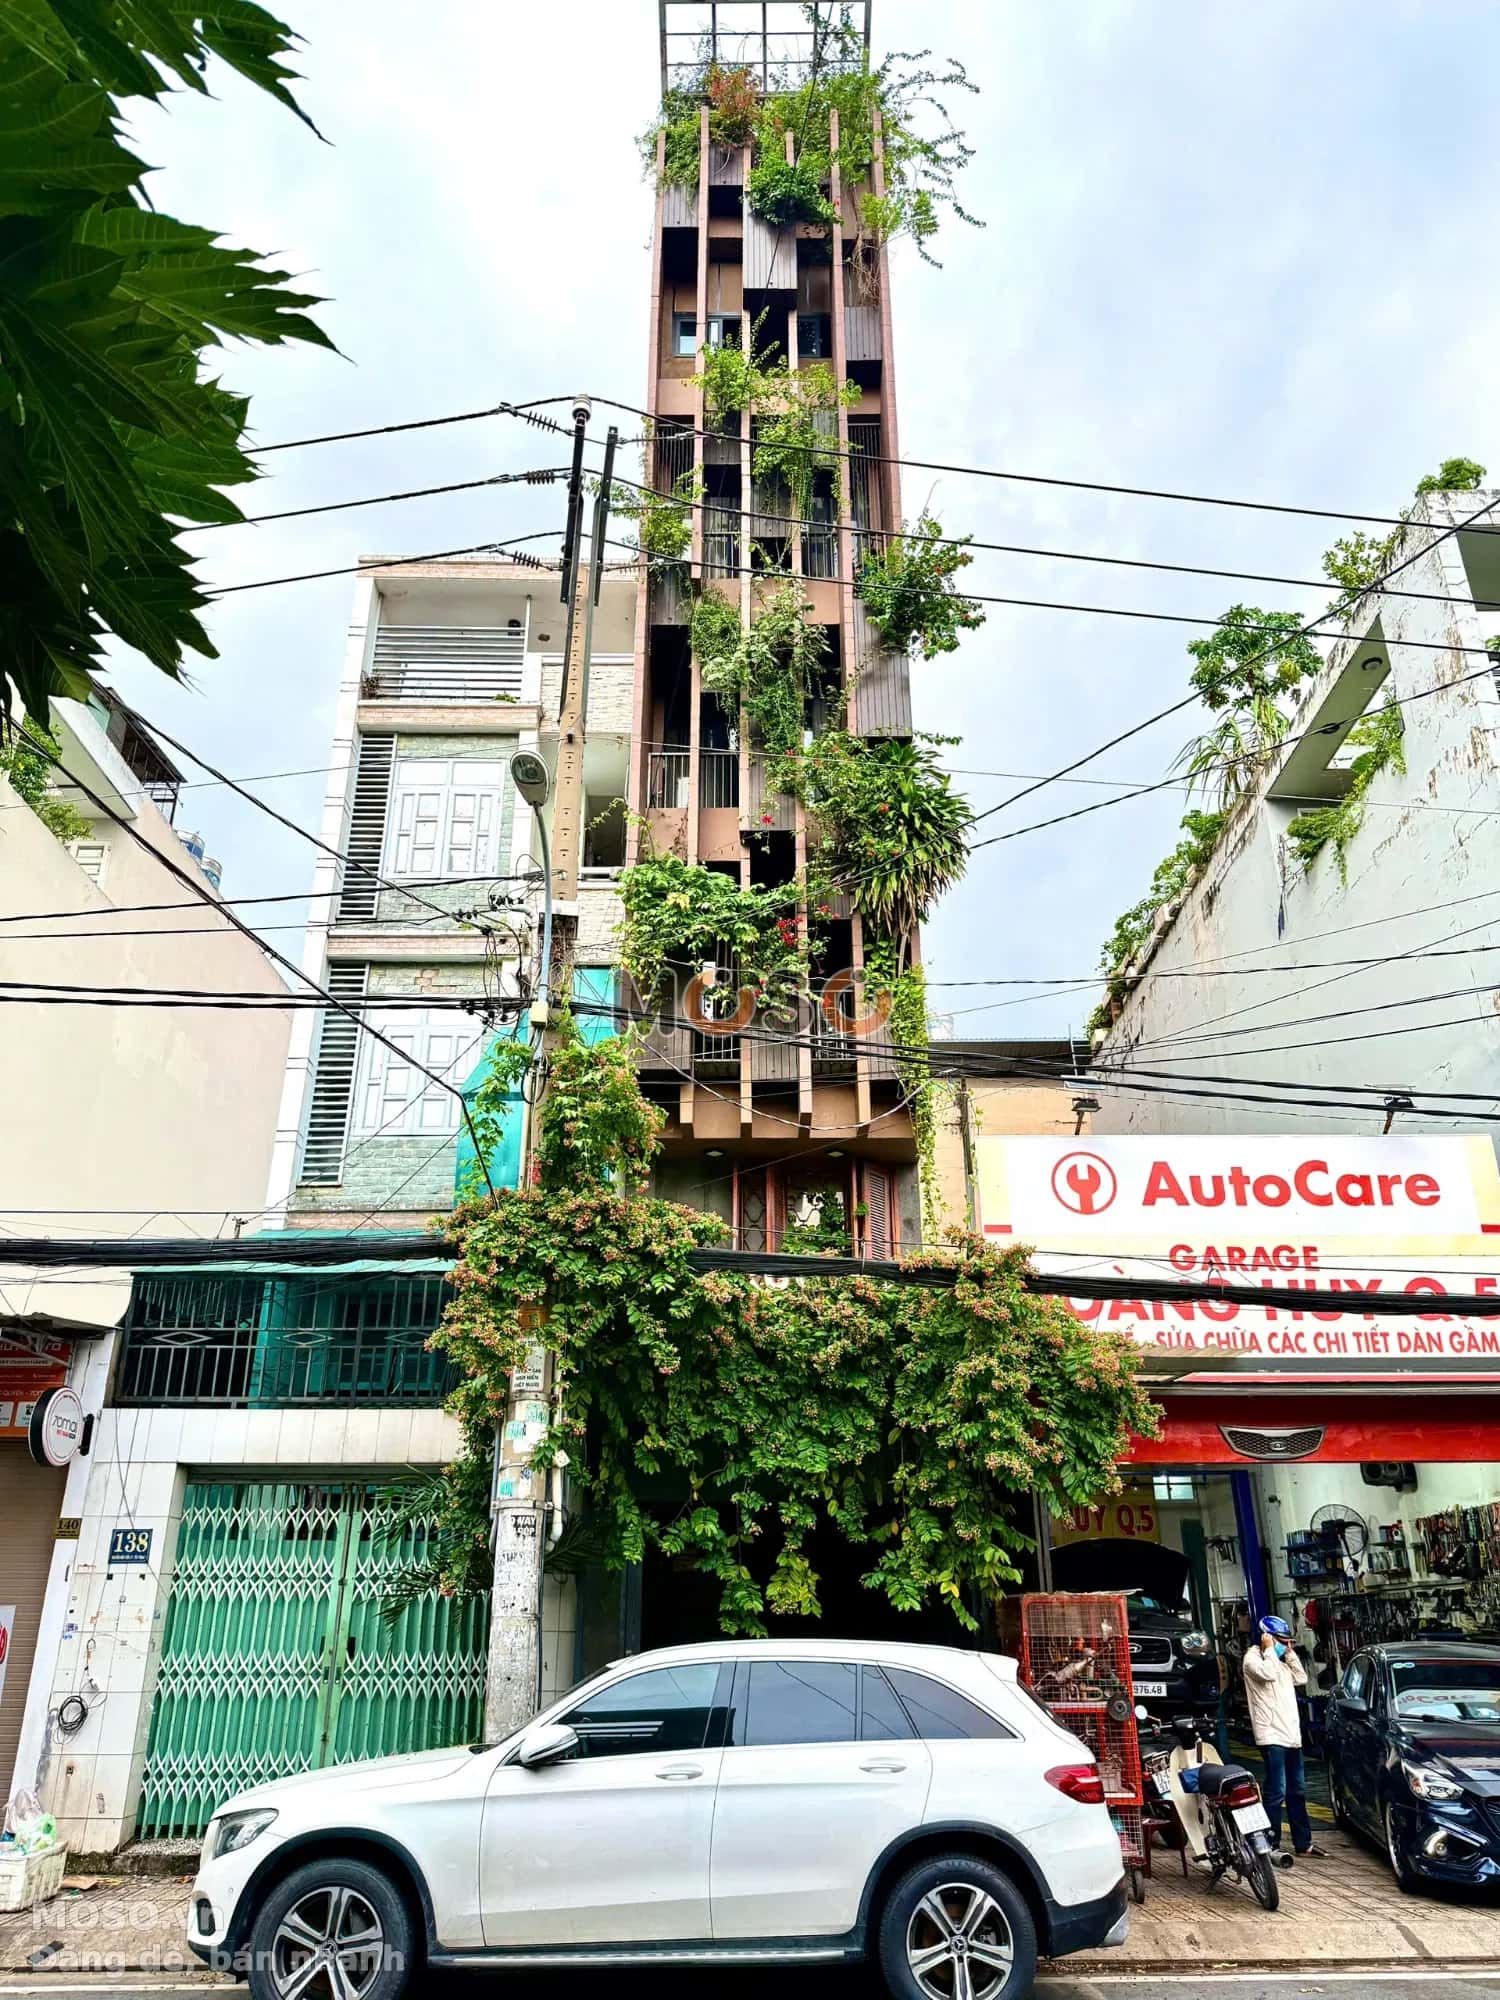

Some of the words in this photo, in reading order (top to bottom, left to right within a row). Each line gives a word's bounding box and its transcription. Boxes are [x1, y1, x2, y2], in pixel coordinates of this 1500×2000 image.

[1142, 1160, 1441, 1207] AutoCare
[1169, 1244, 1321, 1272] GARAGE
[1064, 1264, 1241, 1322] OÀNG
[1204, 1326, 1262, 1353] CHỮA
[1267, 1325, 1307, 1353] CÁC
[1313, 1332, 1347, 1353] CHI
[1353, 1323, 1390, 1353] TIẾT
[1397, 1327, 1443, 1353] DÀN
[1449, 1324, 1500, 1353] GẦM
[57, 1520, 79, 1529] 140
[1072, 1504, 1107, 1532] UY
[1117, 1504, 1155, 1536] Q.5
[114, 1532, 148, 1552] 138
